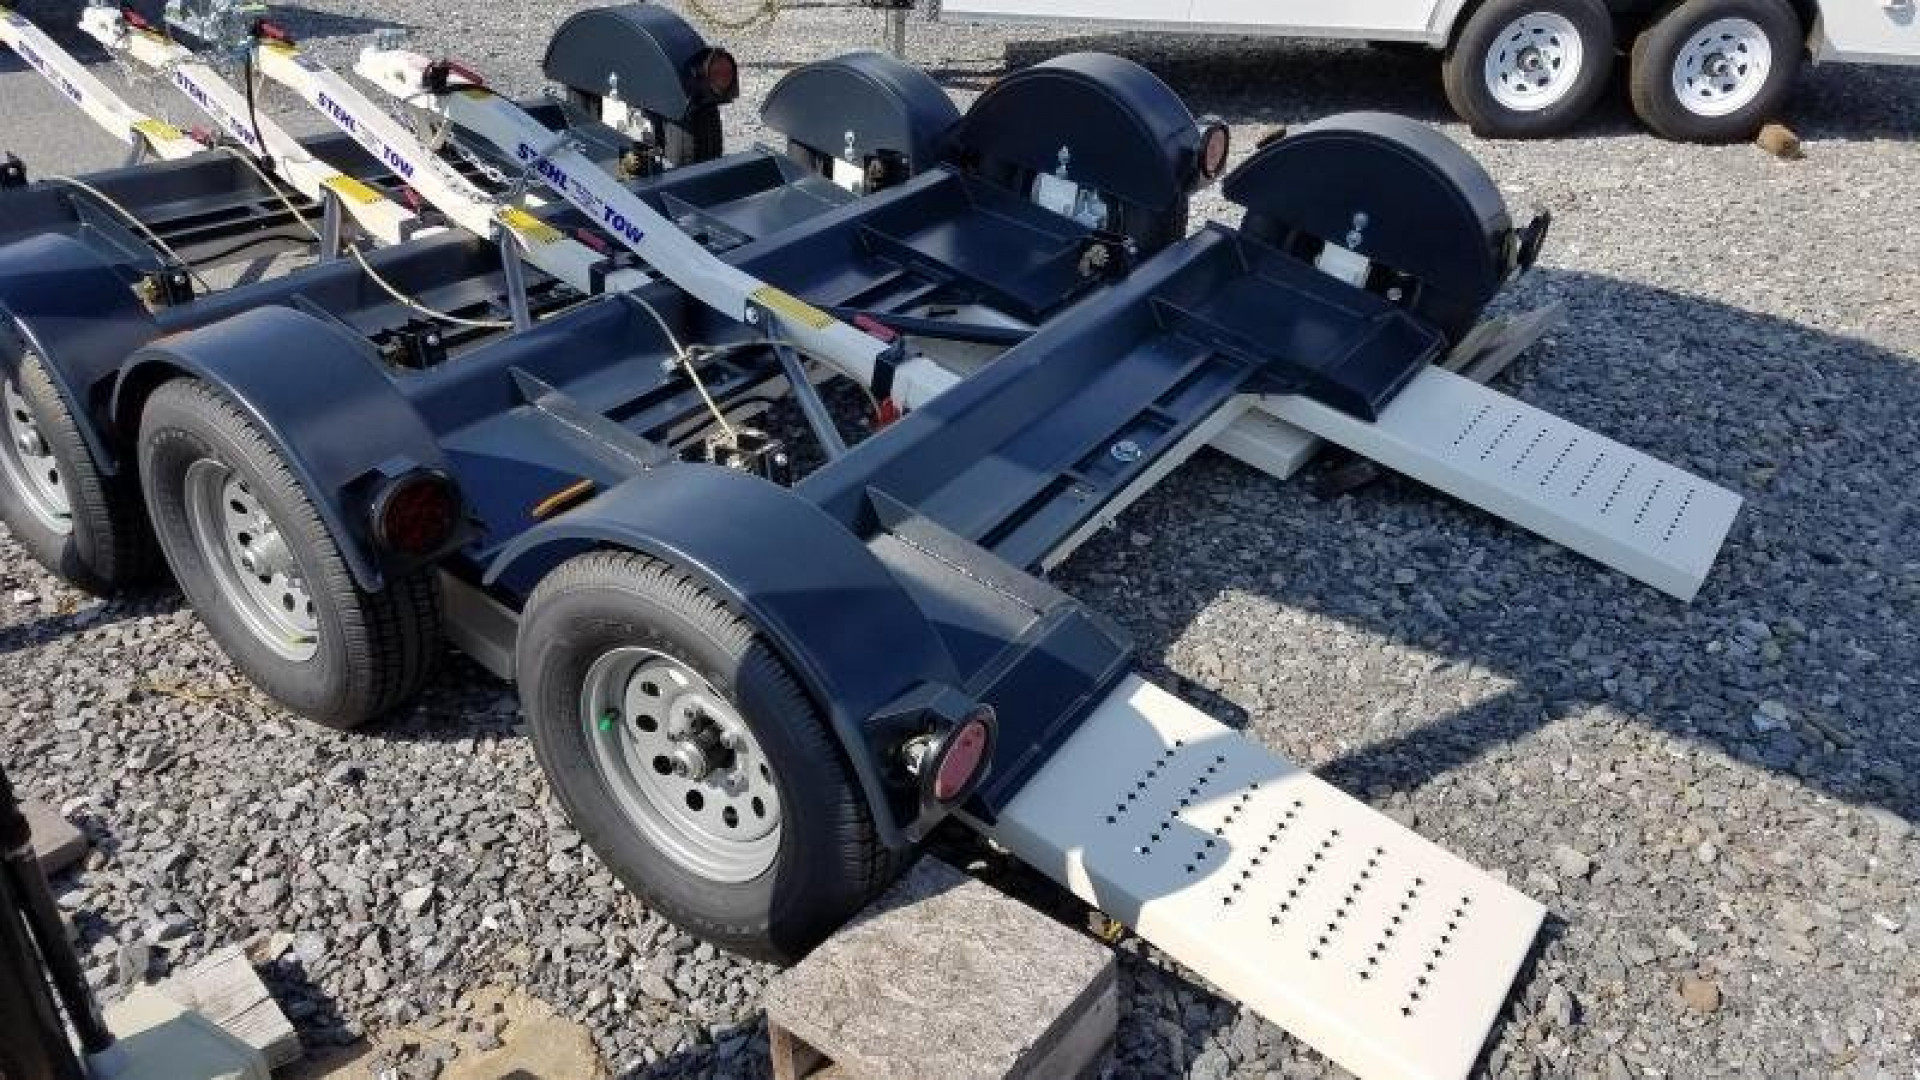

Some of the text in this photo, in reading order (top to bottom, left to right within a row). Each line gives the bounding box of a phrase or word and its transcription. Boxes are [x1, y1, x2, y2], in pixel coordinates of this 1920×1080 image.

[176, 71, 255, 145] STEHL TOW
[318, 90, 414, 178] STEHL TOW
[604, 205, 645, 244] TOW
